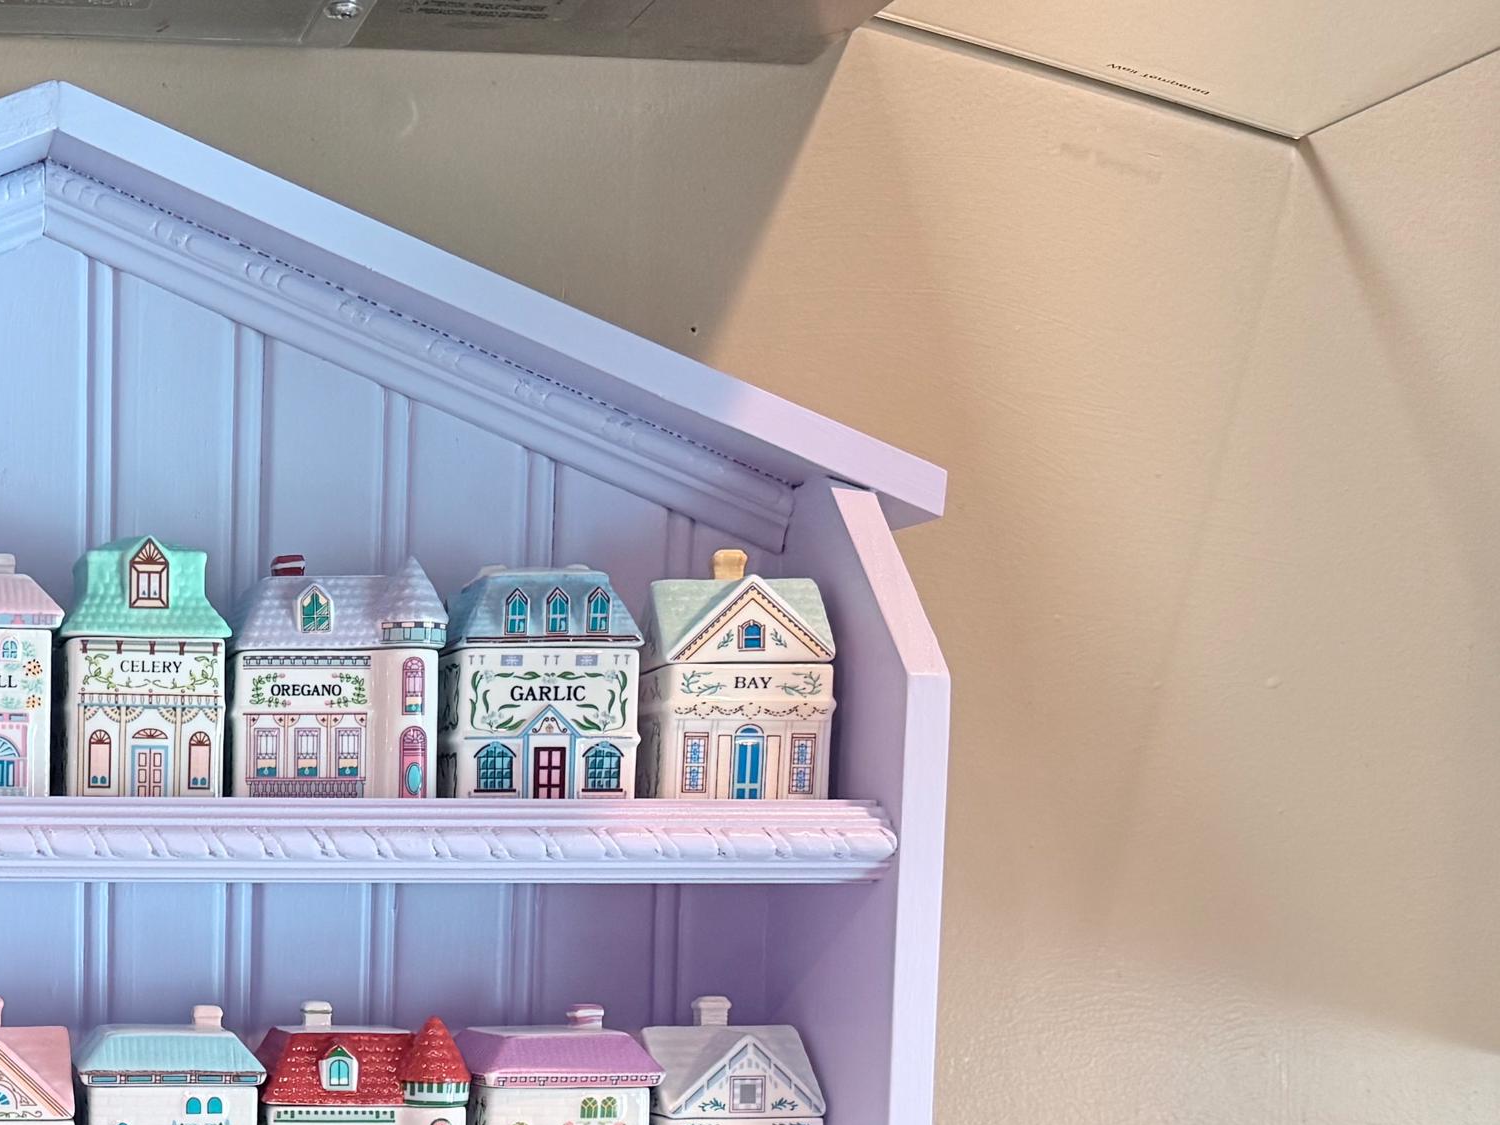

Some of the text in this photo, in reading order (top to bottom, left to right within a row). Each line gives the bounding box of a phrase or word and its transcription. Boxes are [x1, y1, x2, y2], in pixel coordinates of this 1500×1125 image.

[119, 659, 182, 677] CELERY
[270, 681, 342, 700] OREGANO
[733, 674, 773, 691] BAY
[509, 684, 586, 704] GARLIC
